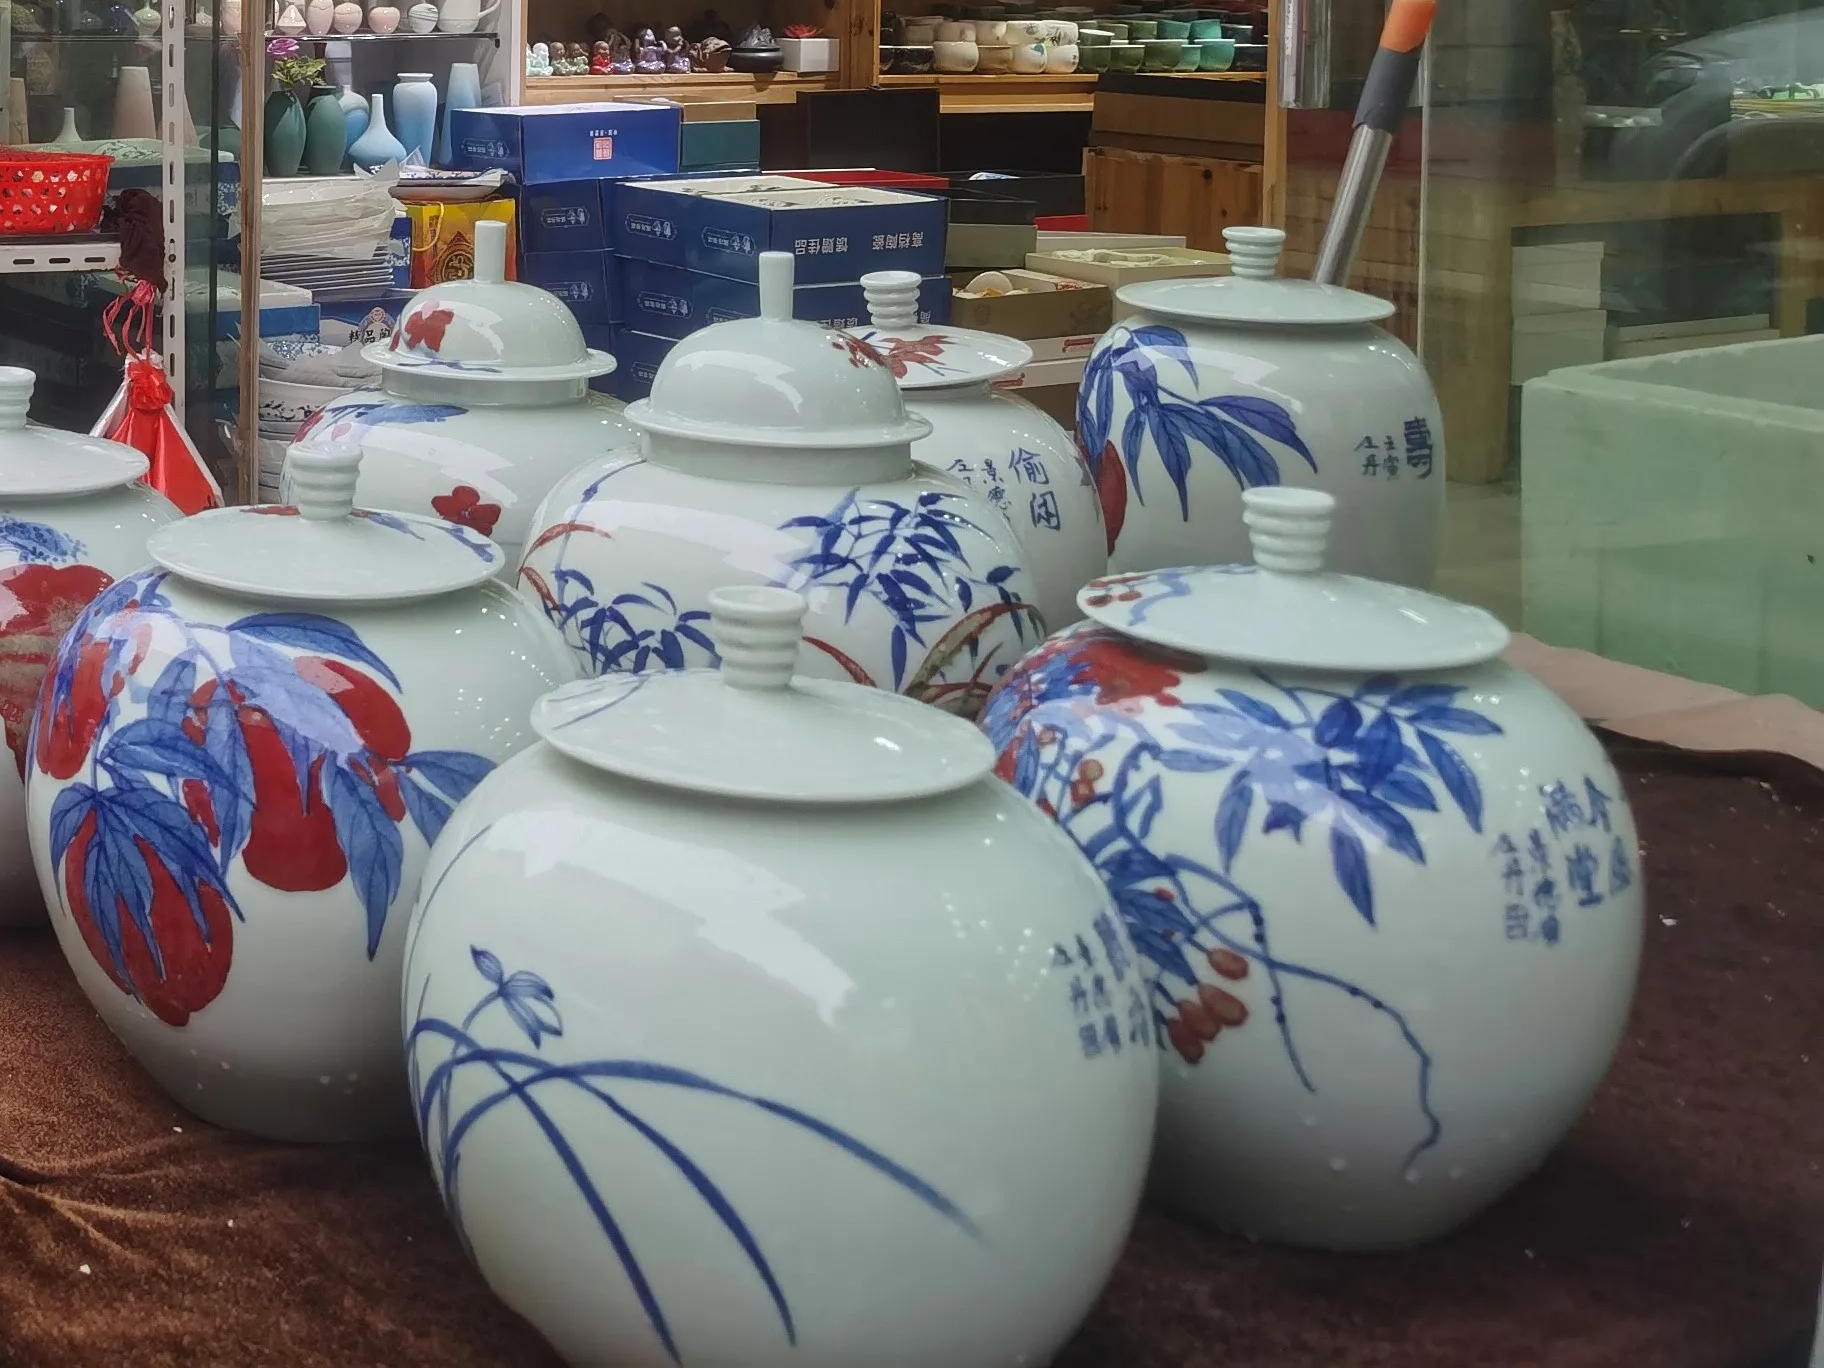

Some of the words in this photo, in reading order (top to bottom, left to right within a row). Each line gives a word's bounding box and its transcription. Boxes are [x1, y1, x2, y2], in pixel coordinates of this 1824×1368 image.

[794, 236, 849, 255] 馈赠佳品
[872, 232, 924, 250] 高档陶瓷
